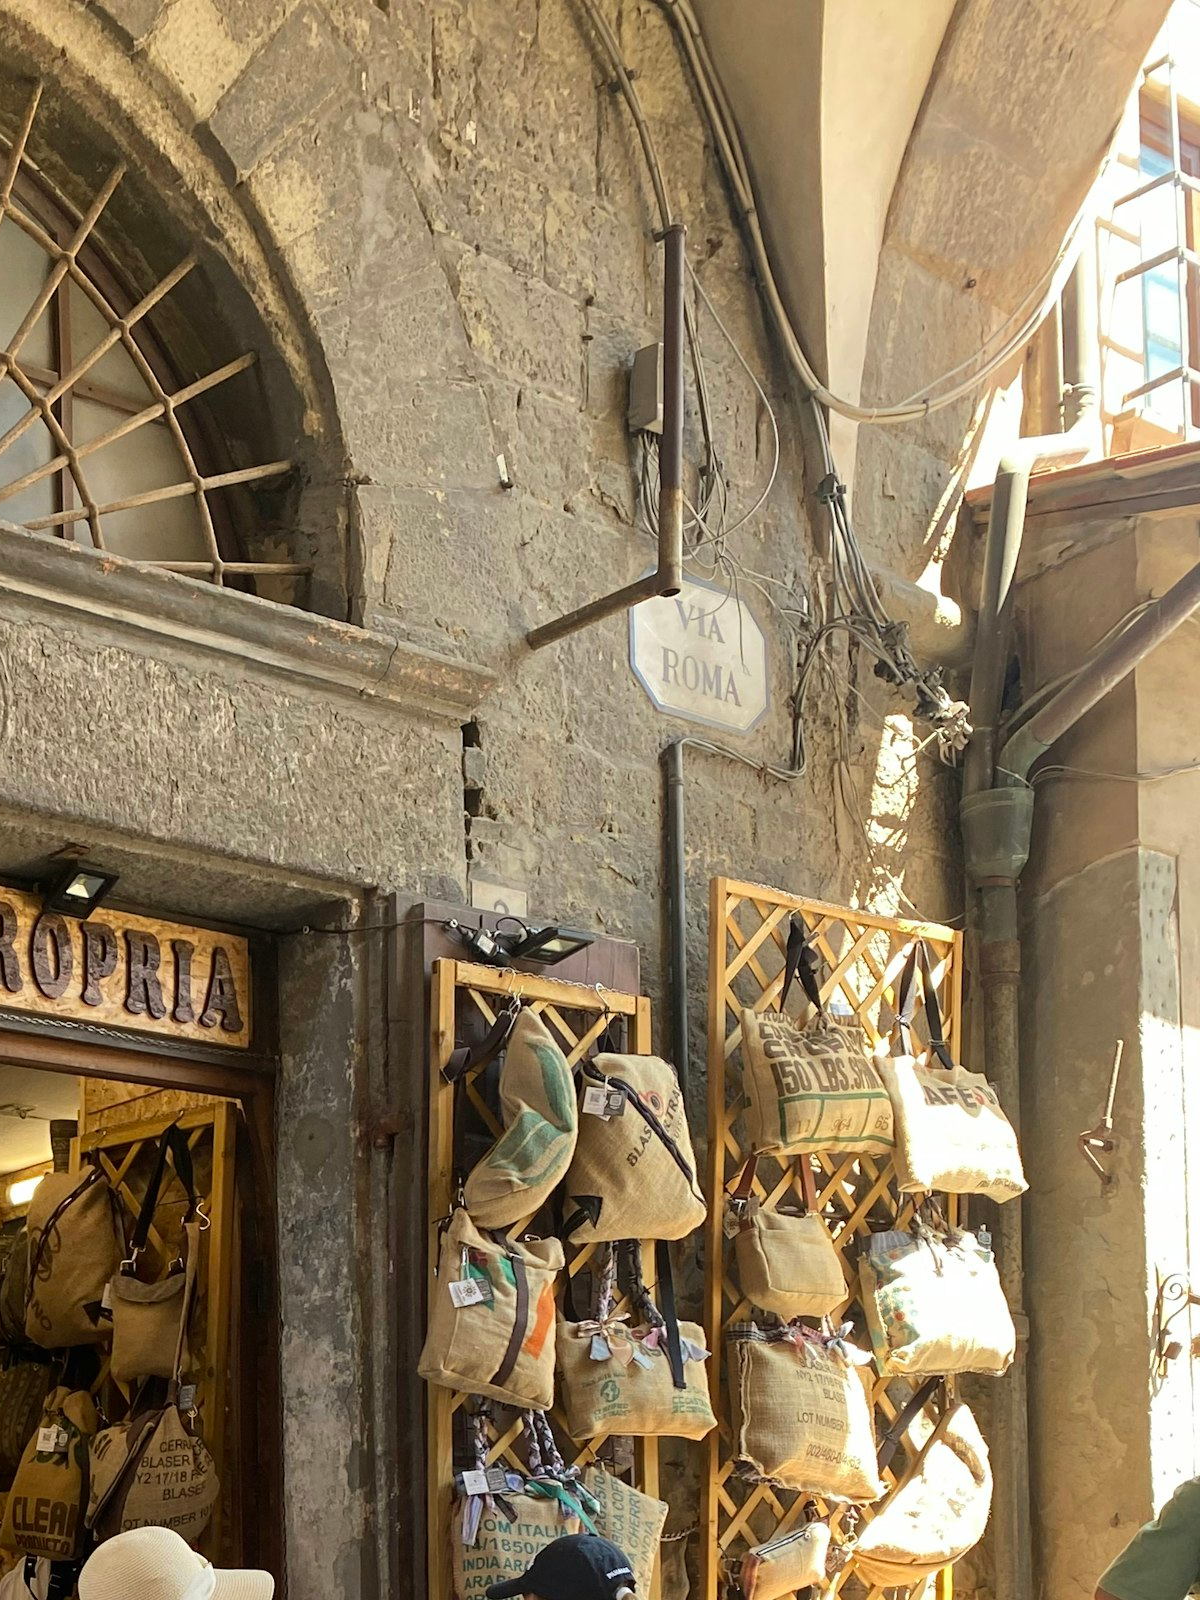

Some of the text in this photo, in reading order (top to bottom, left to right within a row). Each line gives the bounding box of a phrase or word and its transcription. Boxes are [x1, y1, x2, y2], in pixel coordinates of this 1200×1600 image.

[674, 598, 726, 644] VIA
[661, 646, 742, 707] ROMA
[770, 1059, 812, 1097] 150
[797, 1411, 846, 1432] LOT NUMBER
[141, 1455, 192, 1469] BLASER
[156, 1471, 188, 1485] 17/18
[627, 1489, 642, 1548] CHERRY
[517, 1523, 569, 1539] ITALIA
[463, 1555, 501, 1573] INDIA
